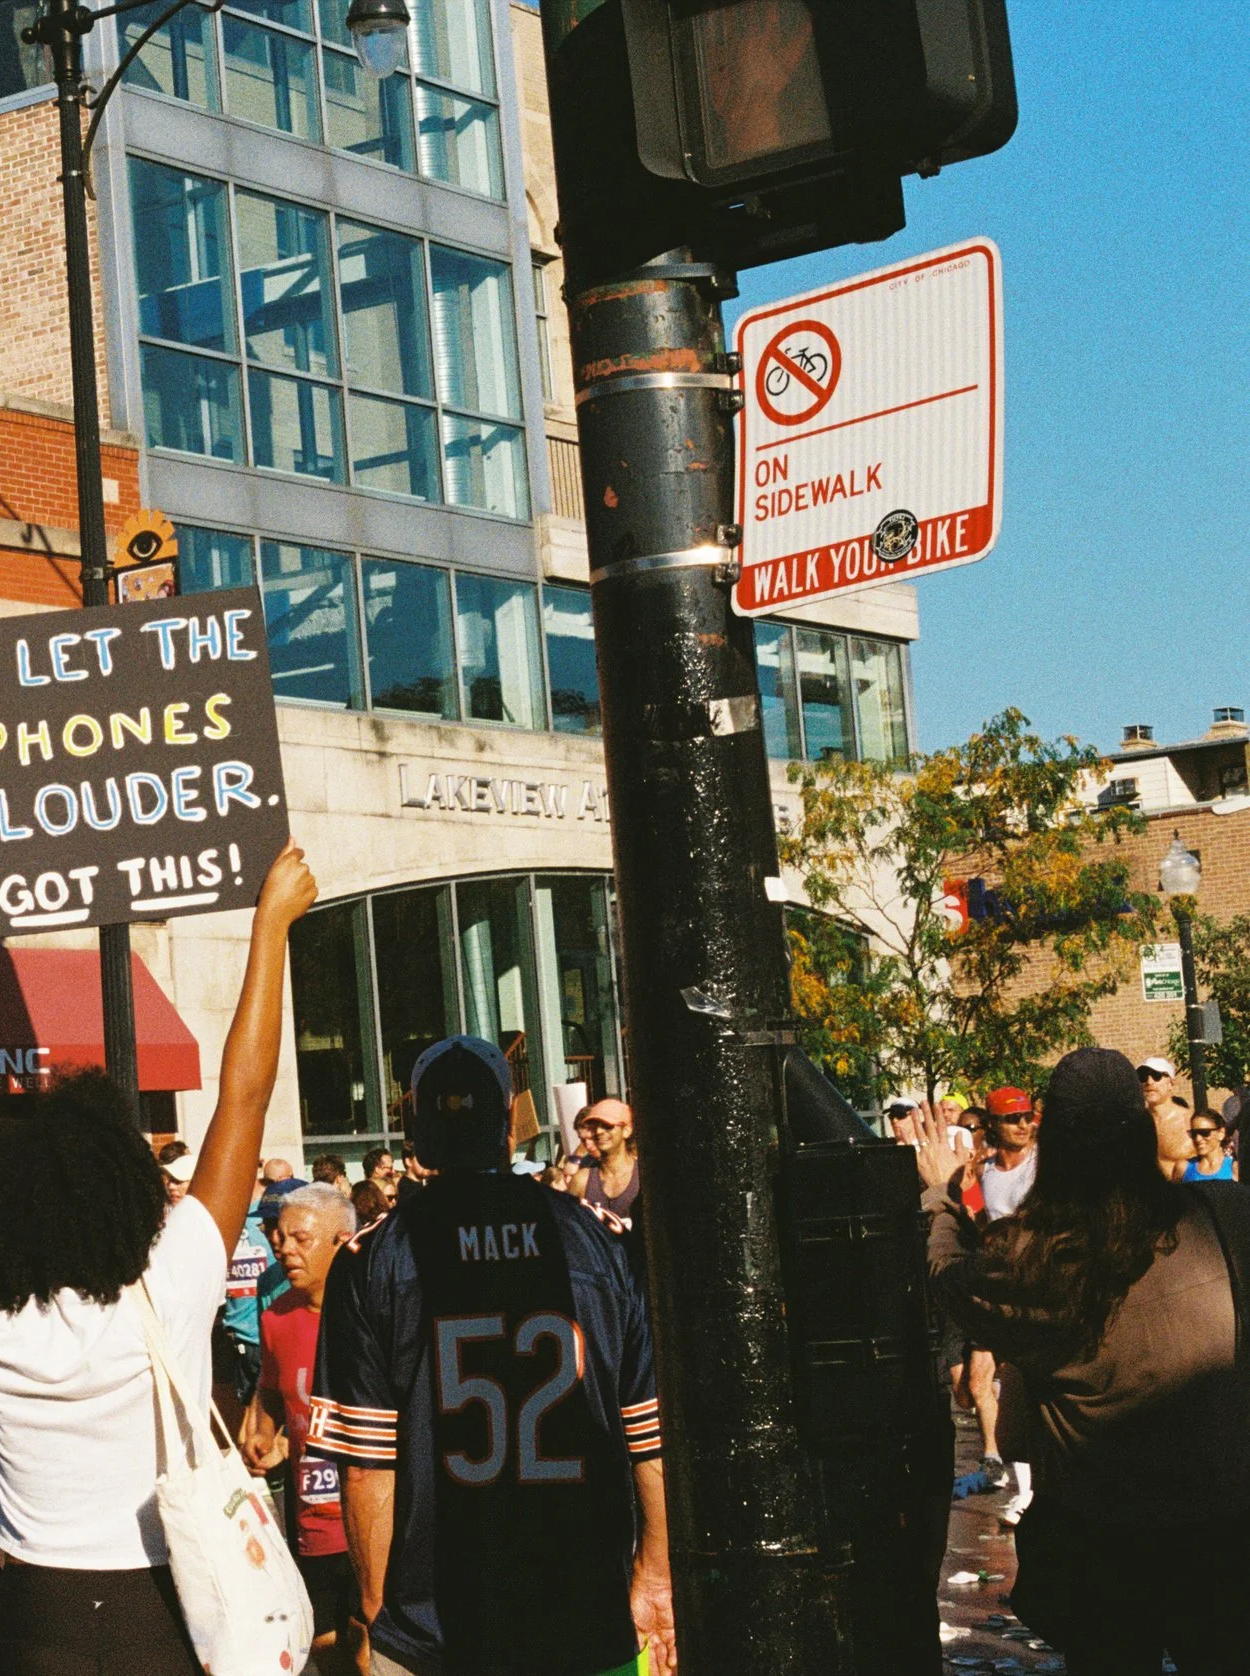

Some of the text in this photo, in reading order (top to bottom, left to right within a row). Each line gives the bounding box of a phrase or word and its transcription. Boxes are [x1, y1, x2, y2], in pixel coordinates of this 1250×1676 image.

[888, 259, 971, 291] CITY OF CHICAGO
[754, 462, 883, 522] SIDEWALK
[755, 454, 789, 488] ON
[754, 552, 820, 603] WALK
[16, 627, 123, 687] LET
[139, 609, 258, 670] THE
[398, 763, 568, 819] LAKEVIEW
[117, 842, 244, 897] THIS!
[458, 1222, 540, 1262] MACK
[434, 1310, 586, 1487] 52
[302, 1468, 339, 1491] F29
